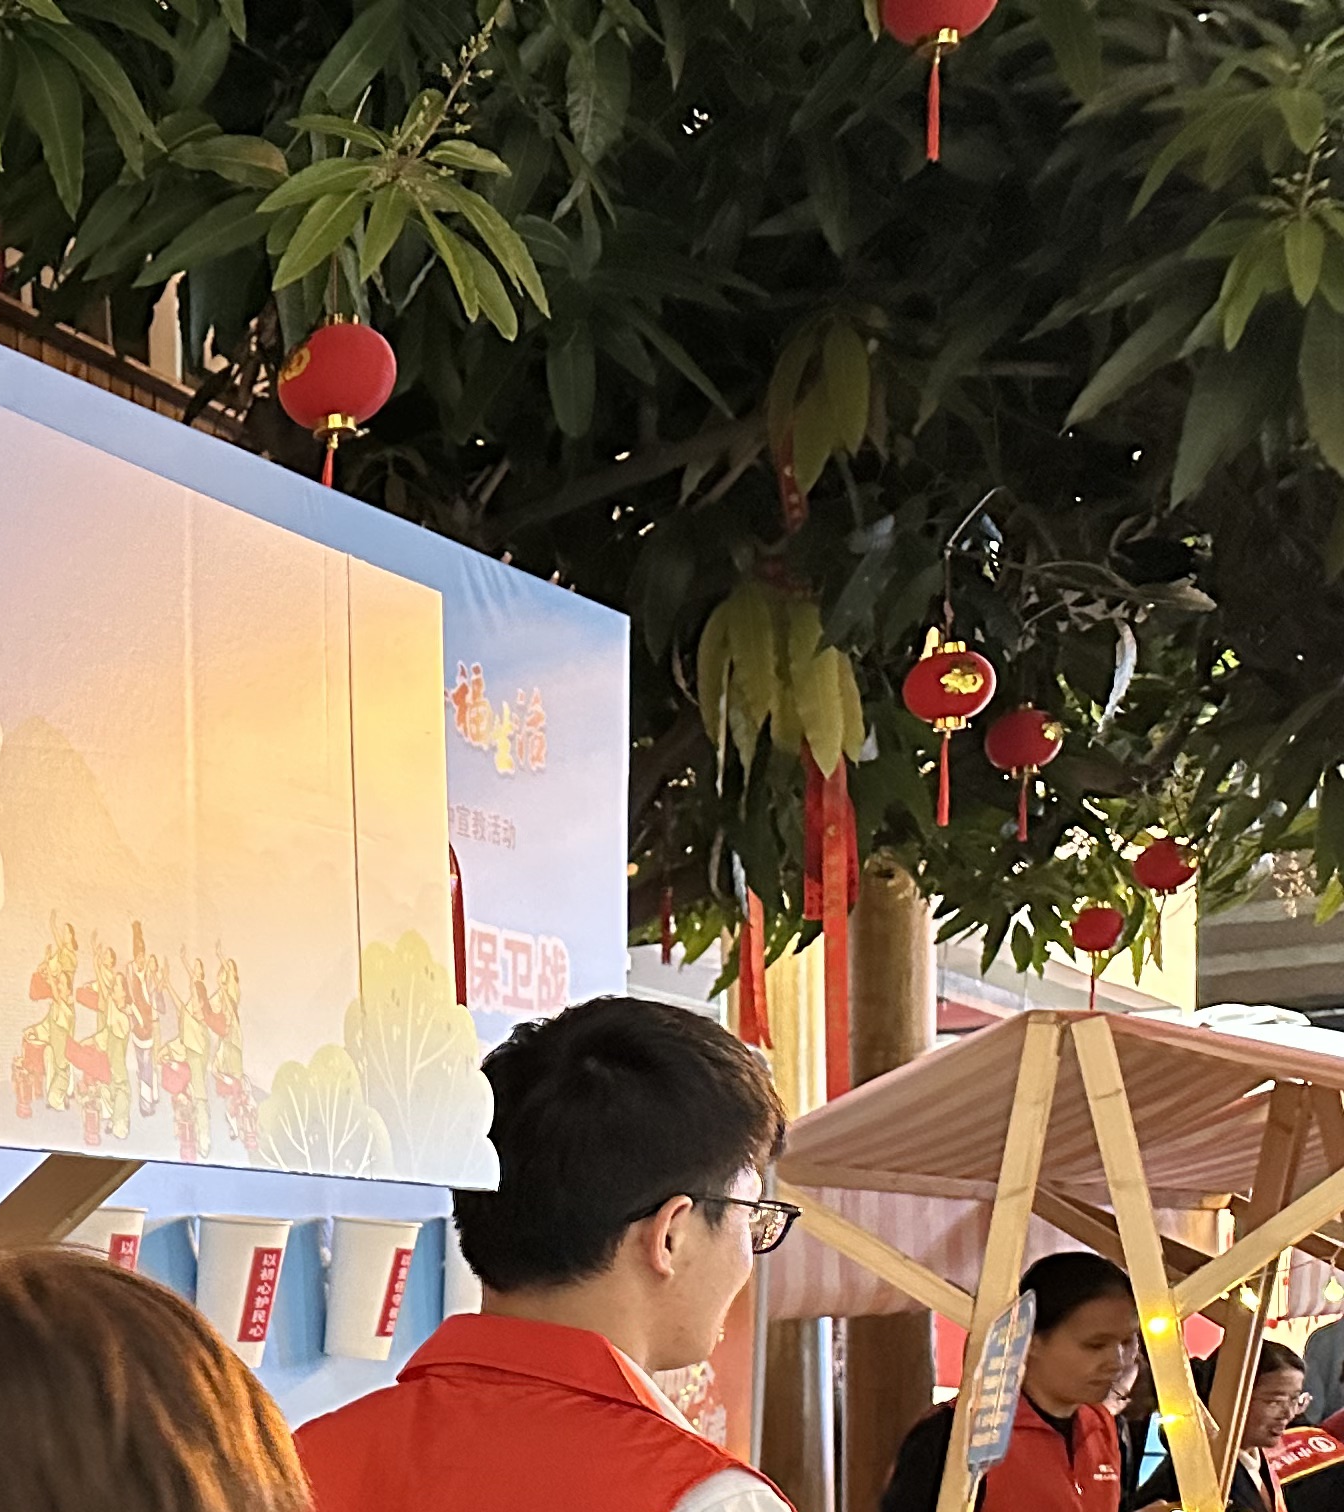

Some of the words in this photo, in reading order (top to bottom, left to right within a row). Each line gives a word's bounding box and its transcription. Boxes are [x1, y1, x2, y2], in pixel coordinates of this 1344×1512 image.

[444, 660, 548, 775] 福生活
[468, 917, 570, 1013] 保卫战
